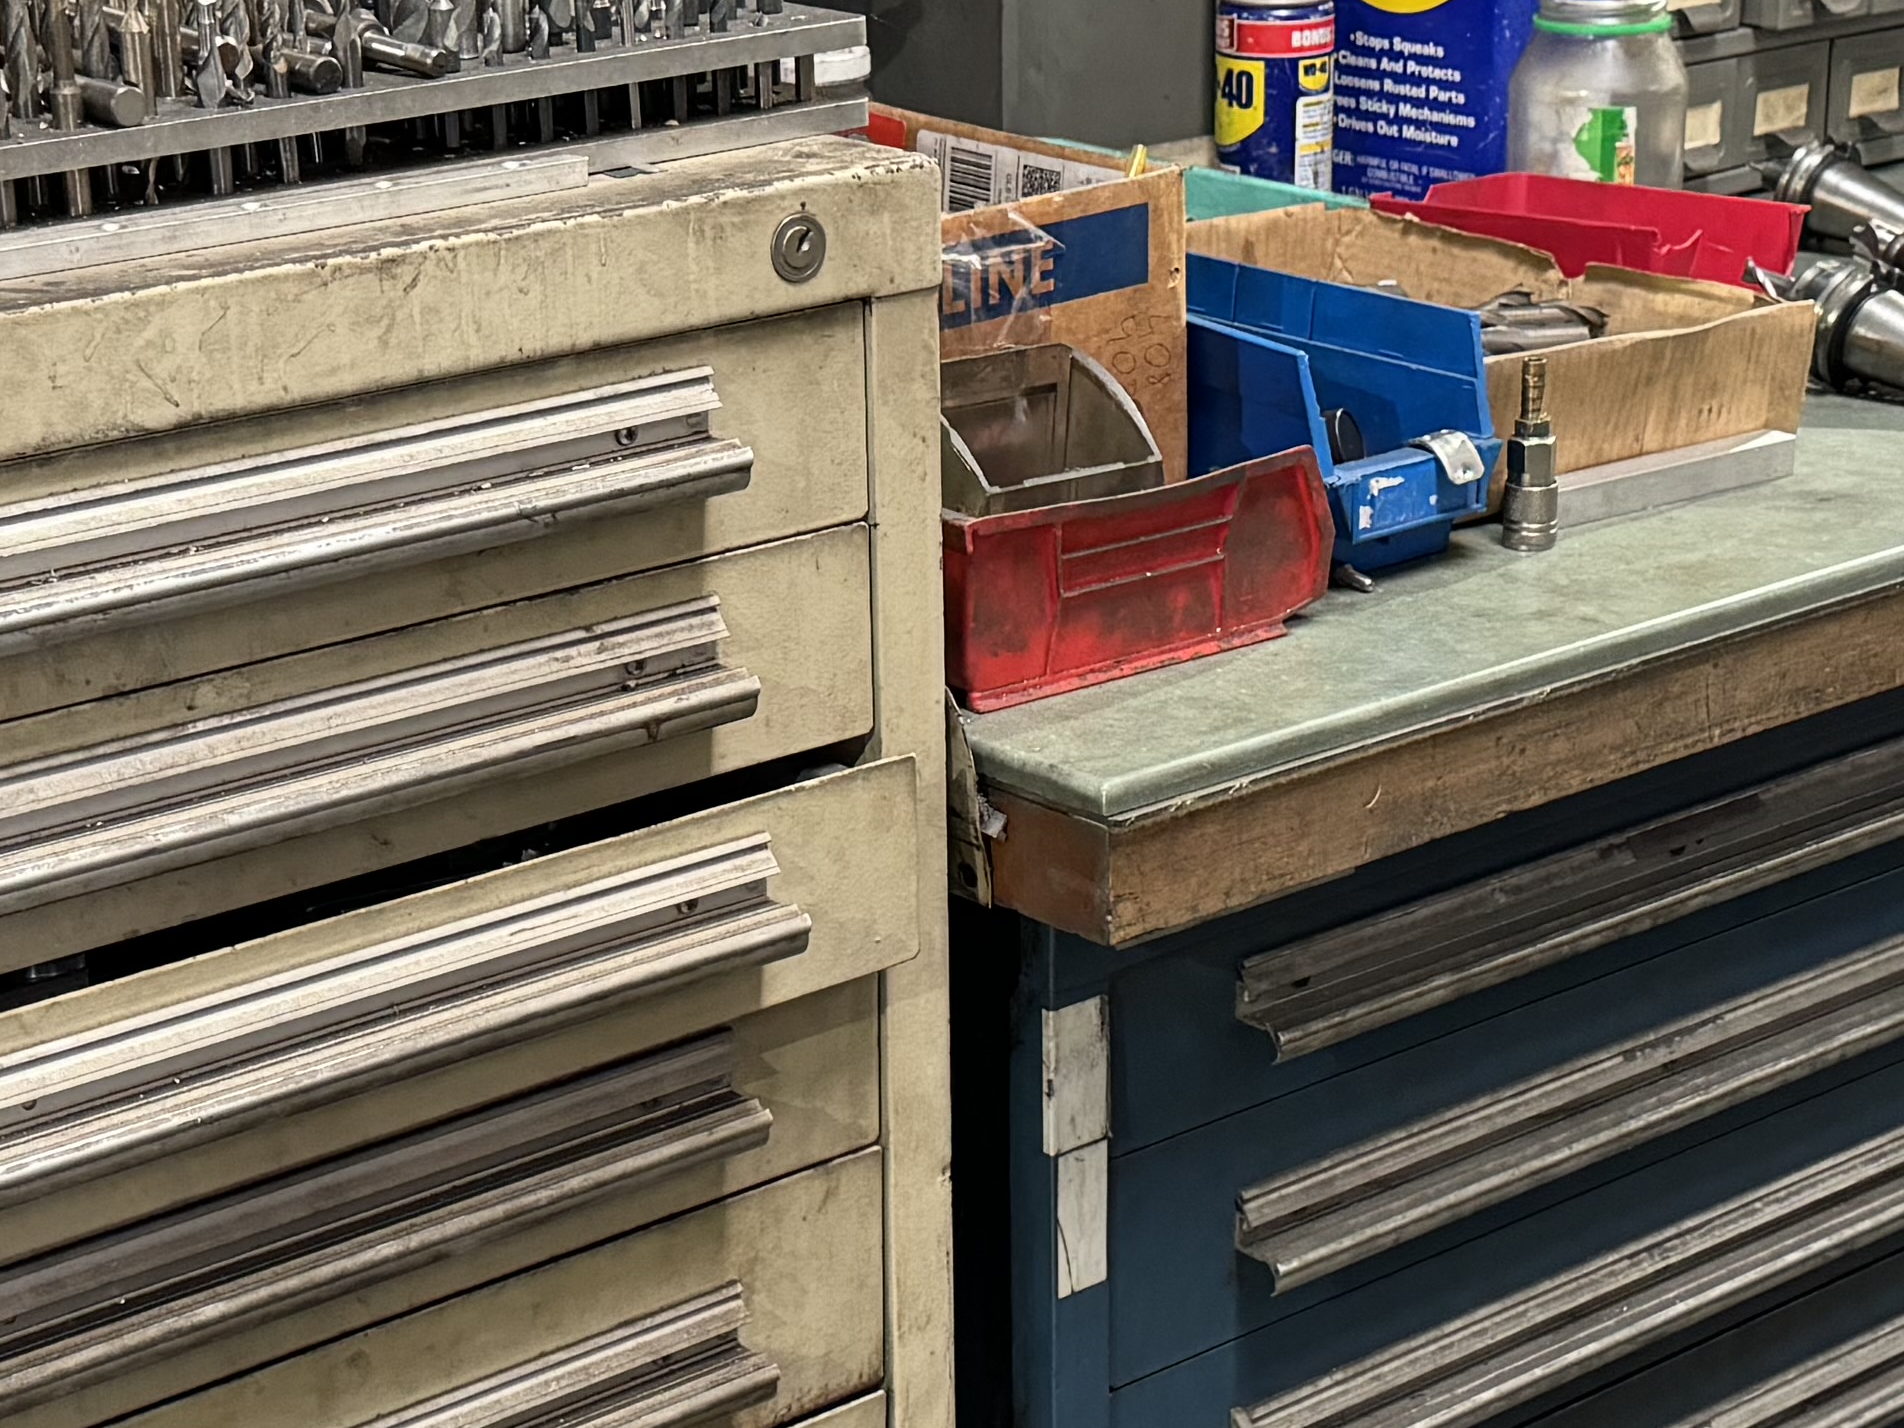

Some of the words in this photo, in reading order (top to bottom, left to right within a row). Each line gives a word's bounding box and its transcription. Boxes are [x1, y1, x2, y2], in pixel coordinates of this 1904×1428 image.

[1355, 31, 1390, 52] Stops
[1393, 36, 1445, 59] Squeaks
[1338, 50, 1377, 70] Cleans
[1380, 57, 1404, 74] And
[1406, 60, 1461, 83] Protects
[1334, 72, 1380, 91] Loosens
[1383, 78, 1426, 99] Rusted
[1429, 85, 1466, 105] Parts
[1359, 95, 1396, 119] Sticky
[1398, 102, 1476, 128] Mechanisms
[1338, 114, 1374, 133] Drives
[1377, 120, 1399, 137] Out
[1402, 124, 1459, 148] Moisture
[943, 239, 1054, 315] LINE
